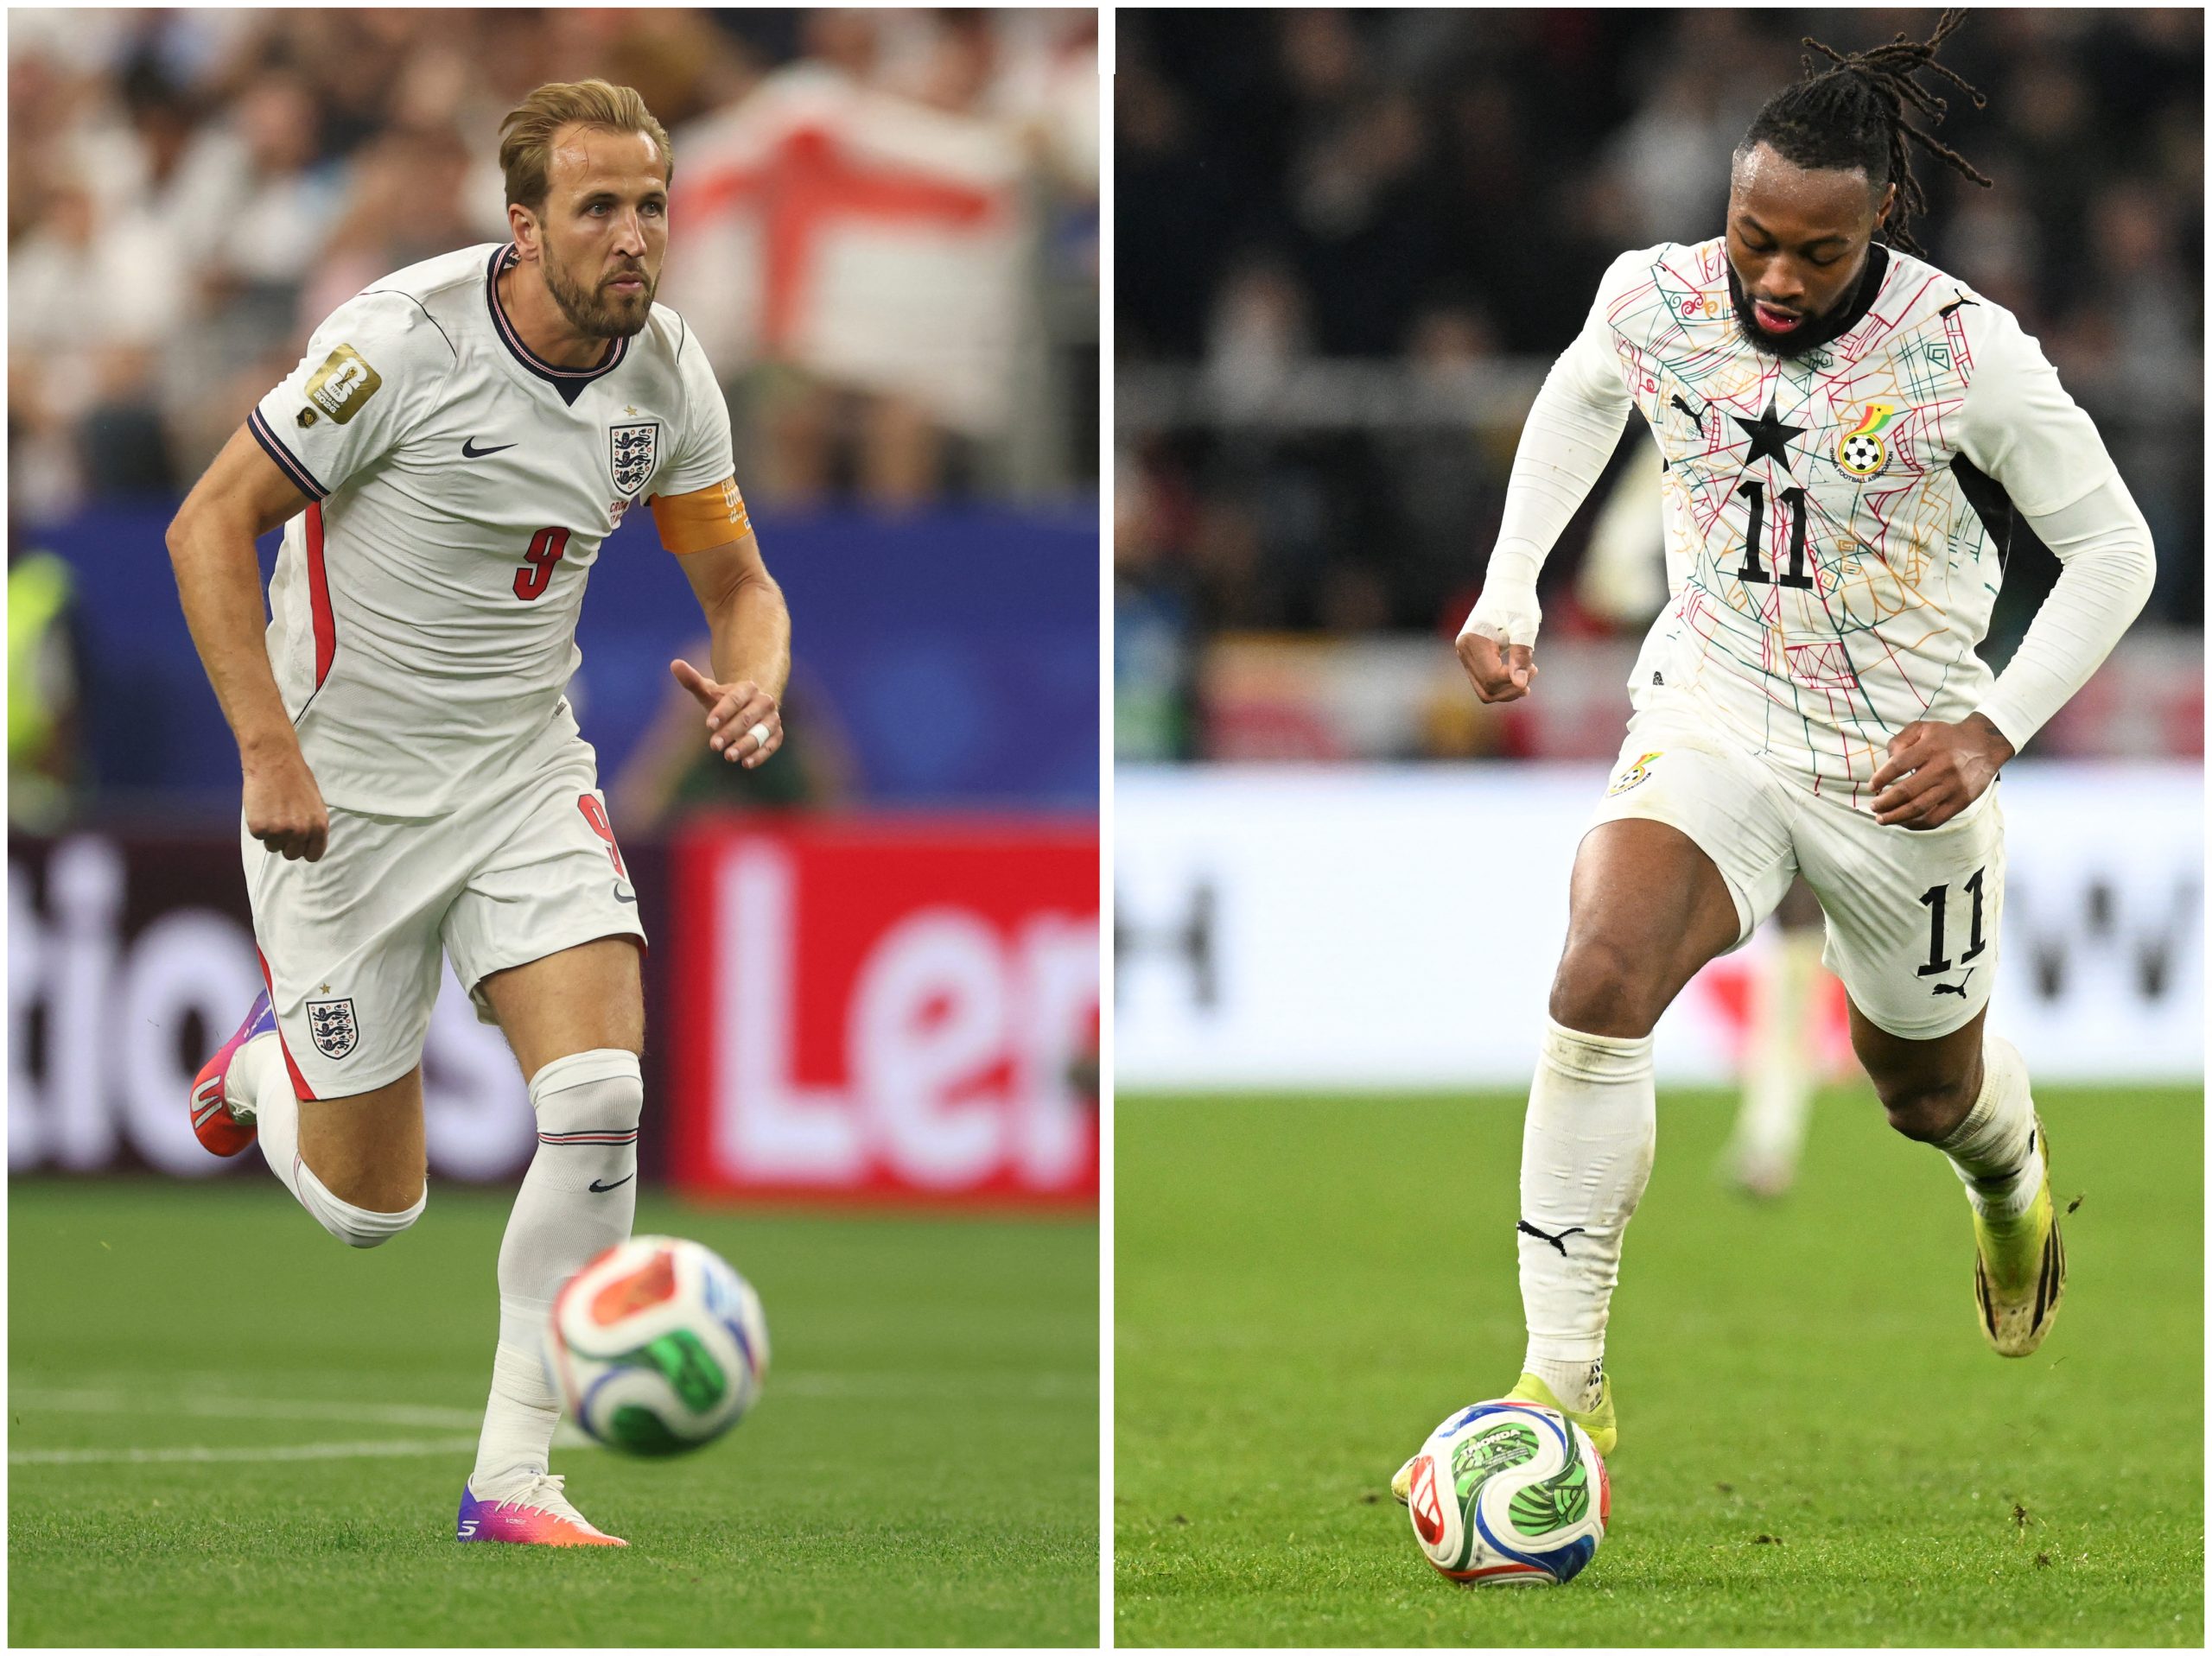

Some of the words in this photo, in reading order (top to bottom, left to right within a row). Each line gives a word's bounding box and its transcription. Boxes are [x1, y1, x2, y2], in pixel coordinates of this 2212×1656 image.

[313, 391, 338, 414] 2026
[318, 387, 333, 402] WORLD
[331, 399, 340, 409] CUP
[330, 385, 340, 397] FIFA
[1836, 467, 1867, 483] FOOTBALL
[1736, 480, 1814, 590] 11
[512, 526, 571, 600] 9
[577, 794, 626, 879] 9
[1916, 865, 1986, 978] 11
